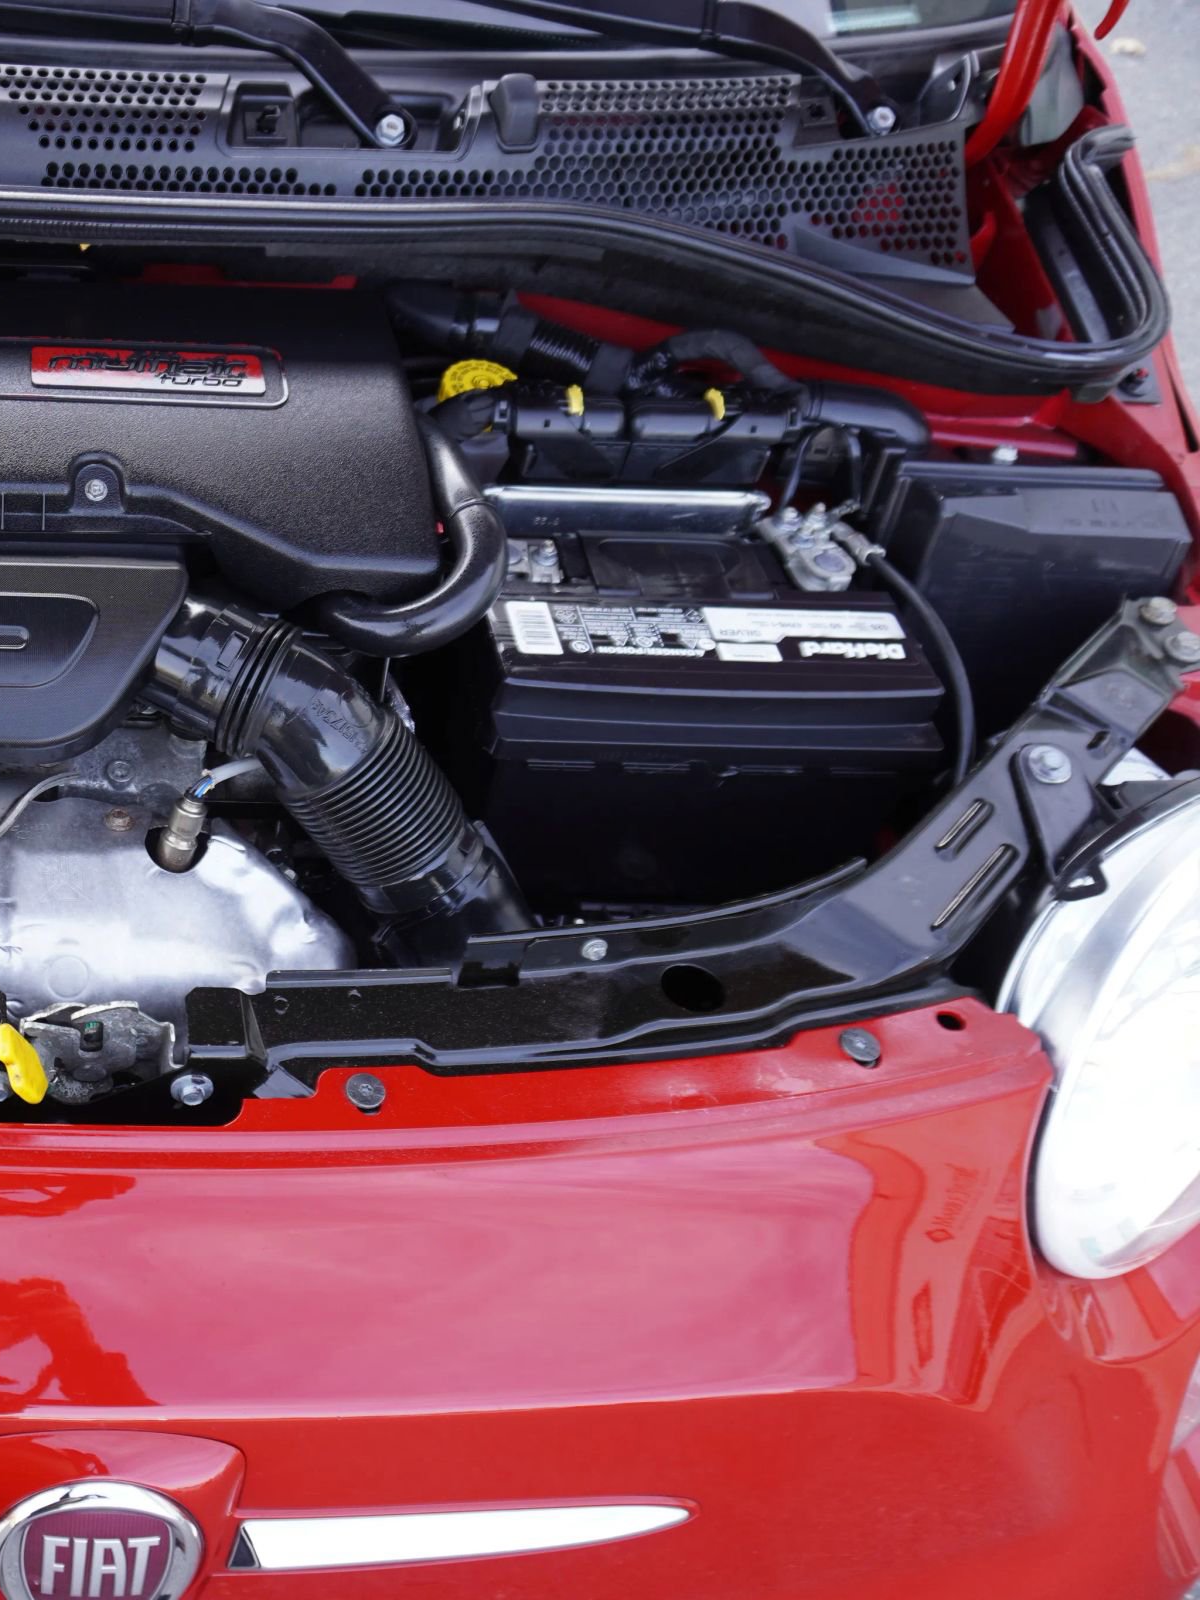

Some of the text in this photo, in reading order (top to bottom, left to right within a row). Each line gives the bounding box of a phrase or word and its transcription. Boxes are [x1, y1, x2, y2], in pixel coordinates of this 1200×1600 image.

[158, 373, 243, 388] turbo
[719, 628, 762, 638] SILVER
[799, 641, 906, 660] DieHard
[41, 1535, 161, 1597] FIAT
